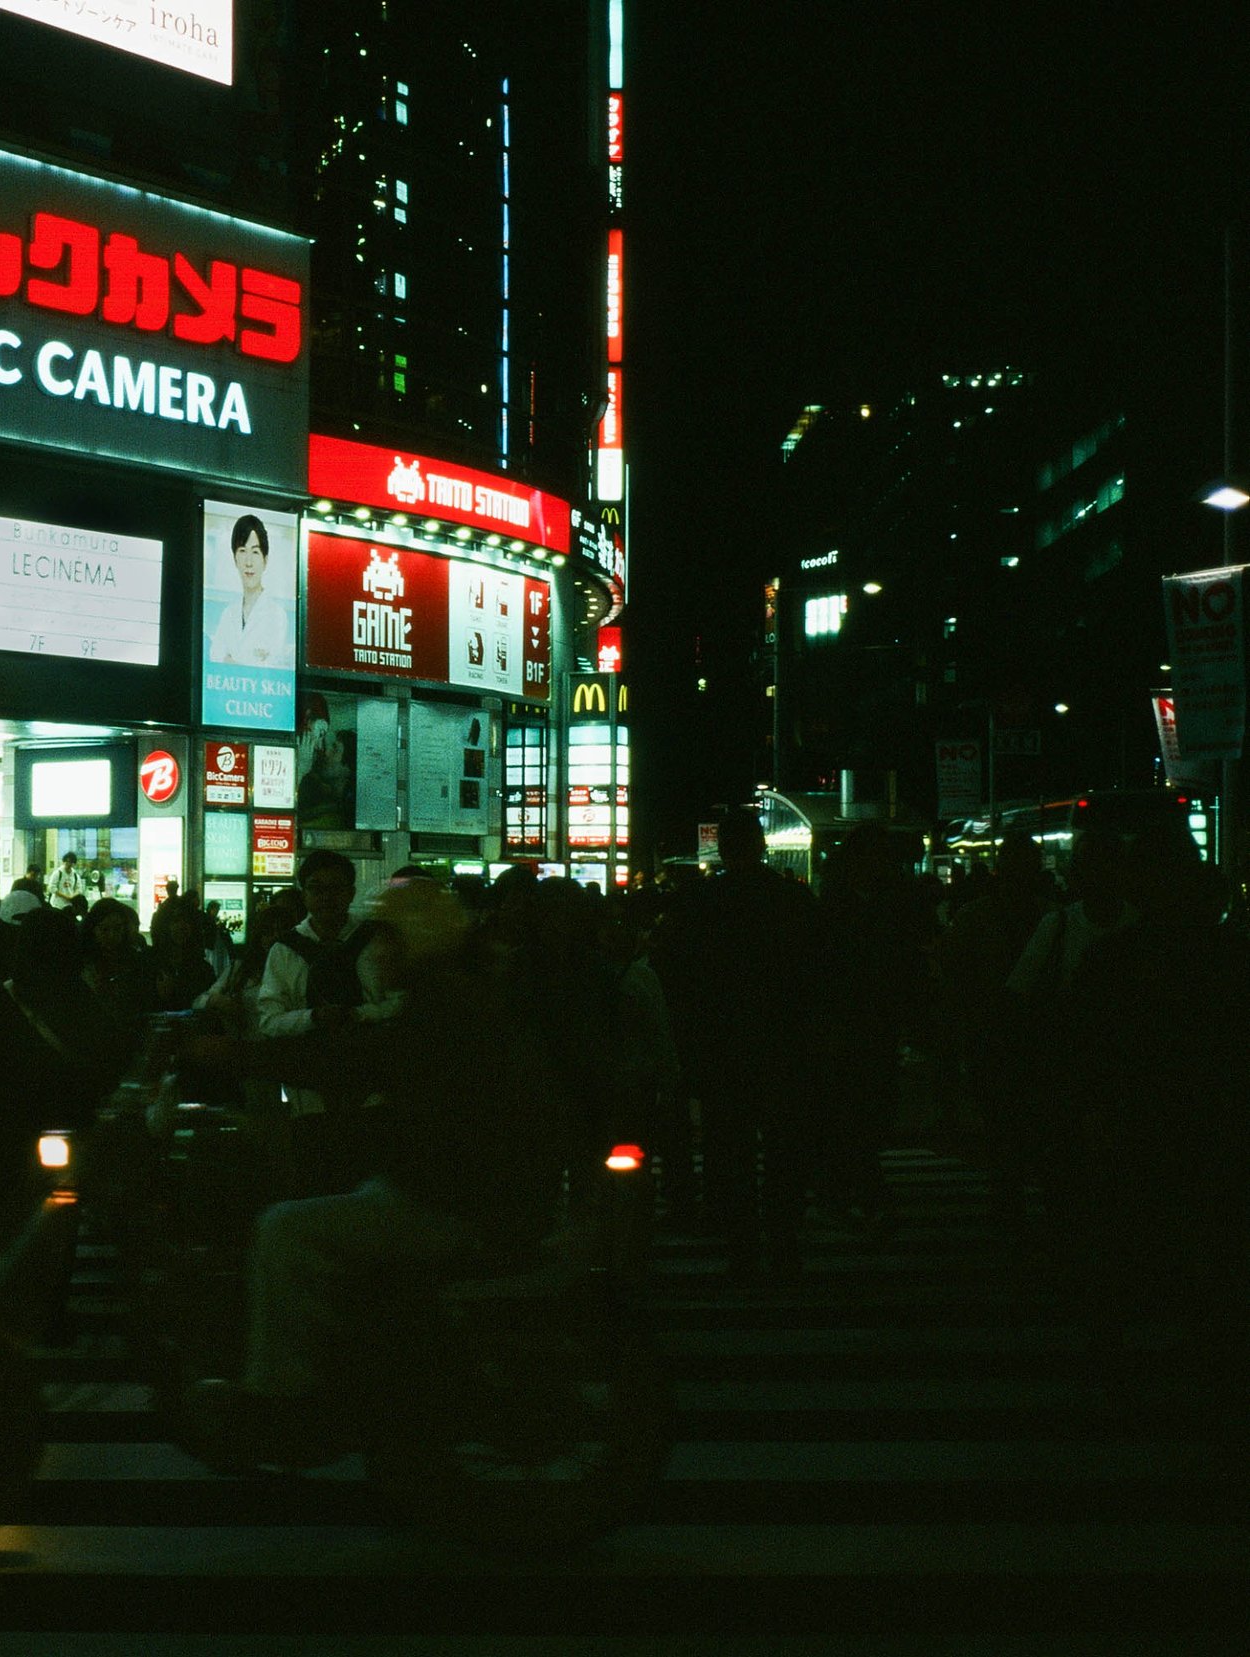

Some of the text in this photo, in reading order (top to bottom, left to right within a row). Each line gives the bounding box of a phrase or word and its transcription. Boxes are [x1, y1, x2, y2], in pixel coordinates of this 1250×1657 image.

[150, 0, 219, 48] iroha
[36, 340, 254, 437] CAMERA
[426, 472, 530, 529] TAITO STATION
[13, 522, 120, 553] Bunkamura
[529, 590, 544, 616] 1F
[1172, 581, 1237, 625] NO
[352, 599, 413, 651] GAME
[29, 634, 46, 651] 7F
[353, 648, 413, 669] TAITO STATION
[206, 672, 292, 697] BEAUTY SKIN
[526, 660, 545, 684] B1F
[224, 699, 274, 720] CLINIC
[206, 771, 246, 783] BicCamera
